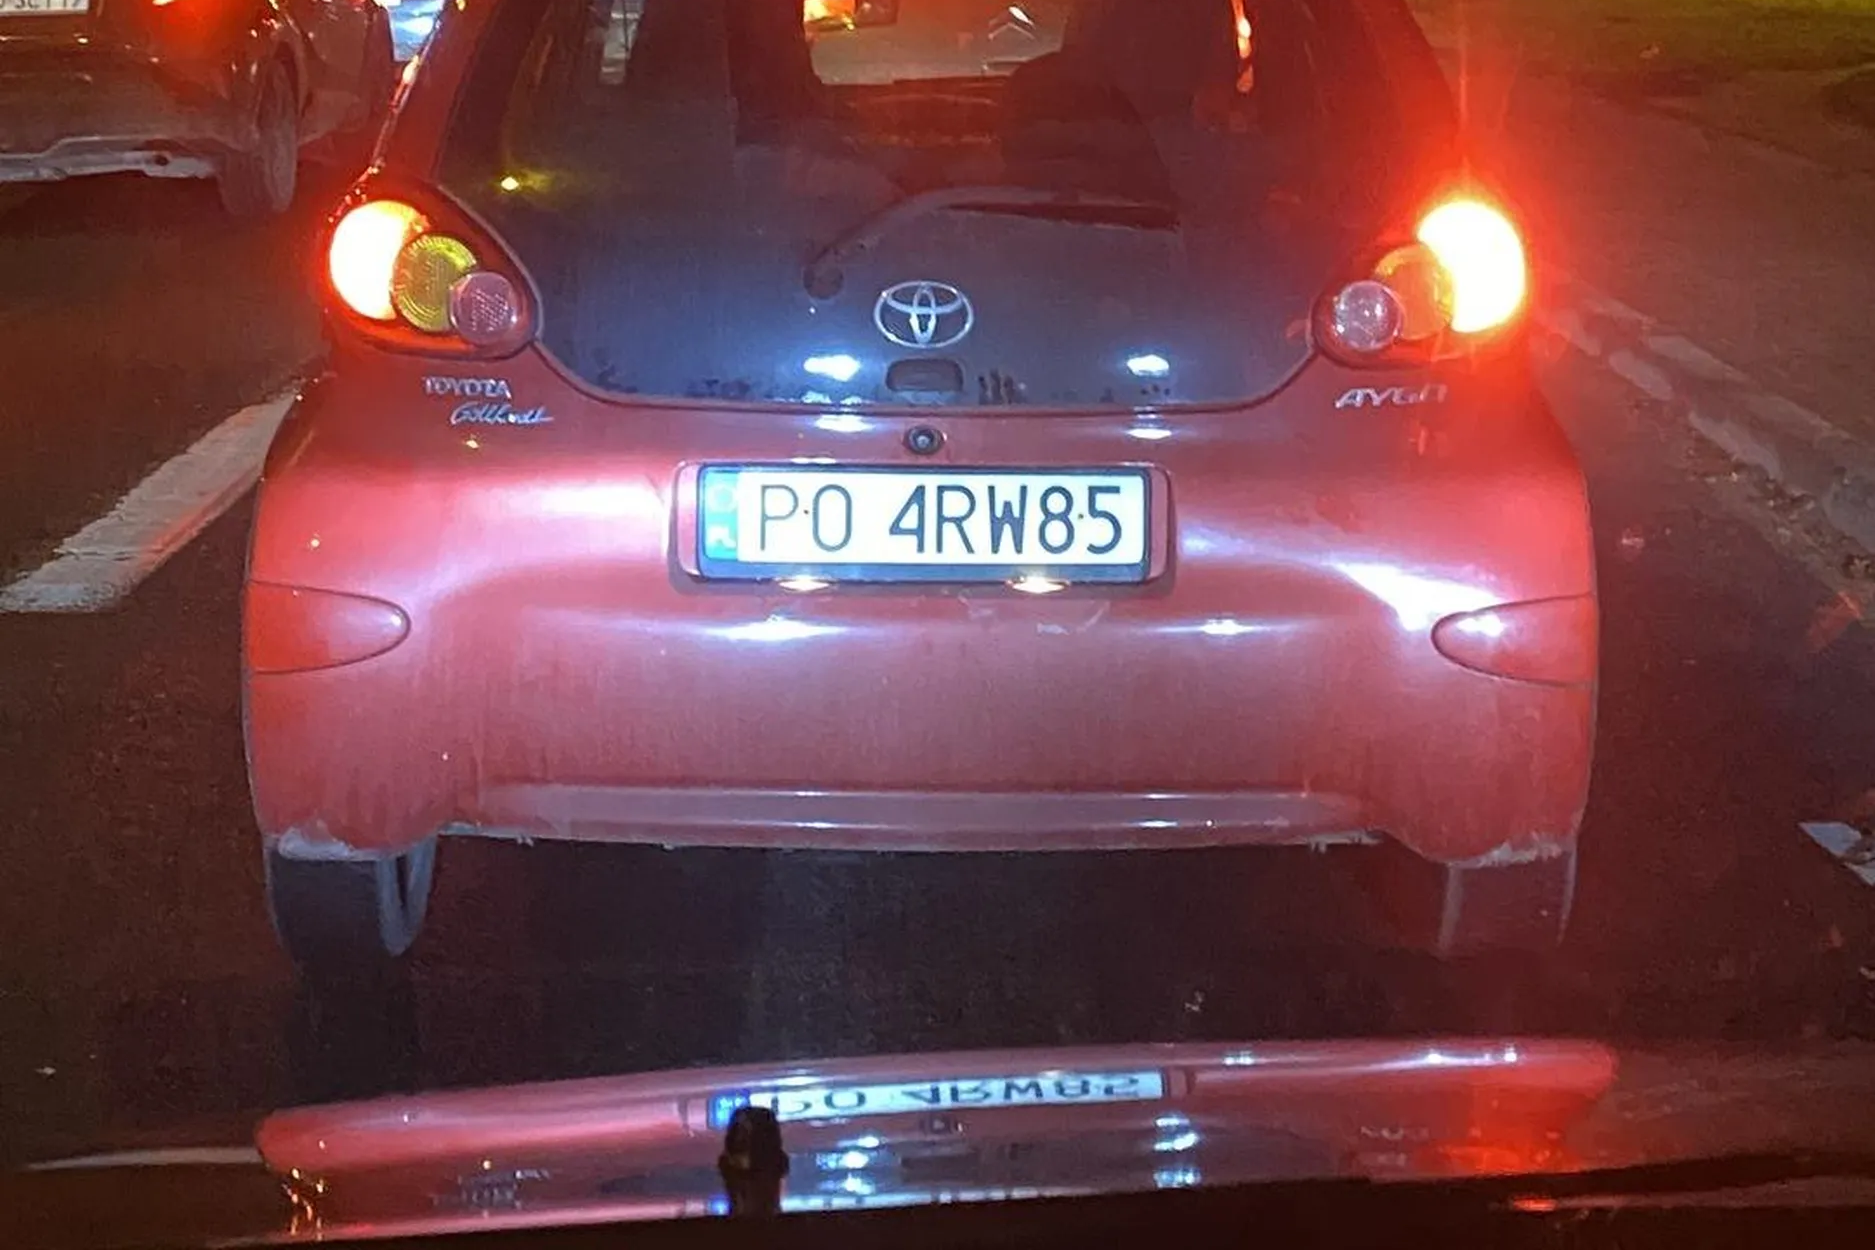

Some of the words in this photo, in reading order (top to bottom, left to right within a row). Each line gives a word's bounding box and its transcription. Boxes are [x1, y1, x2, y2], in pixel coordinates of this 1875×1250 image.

[422, 375, 512, 400] TOYOTA
[759, 483, 853, 553] PO
[888, 483, 1123, 555] 4RW85
